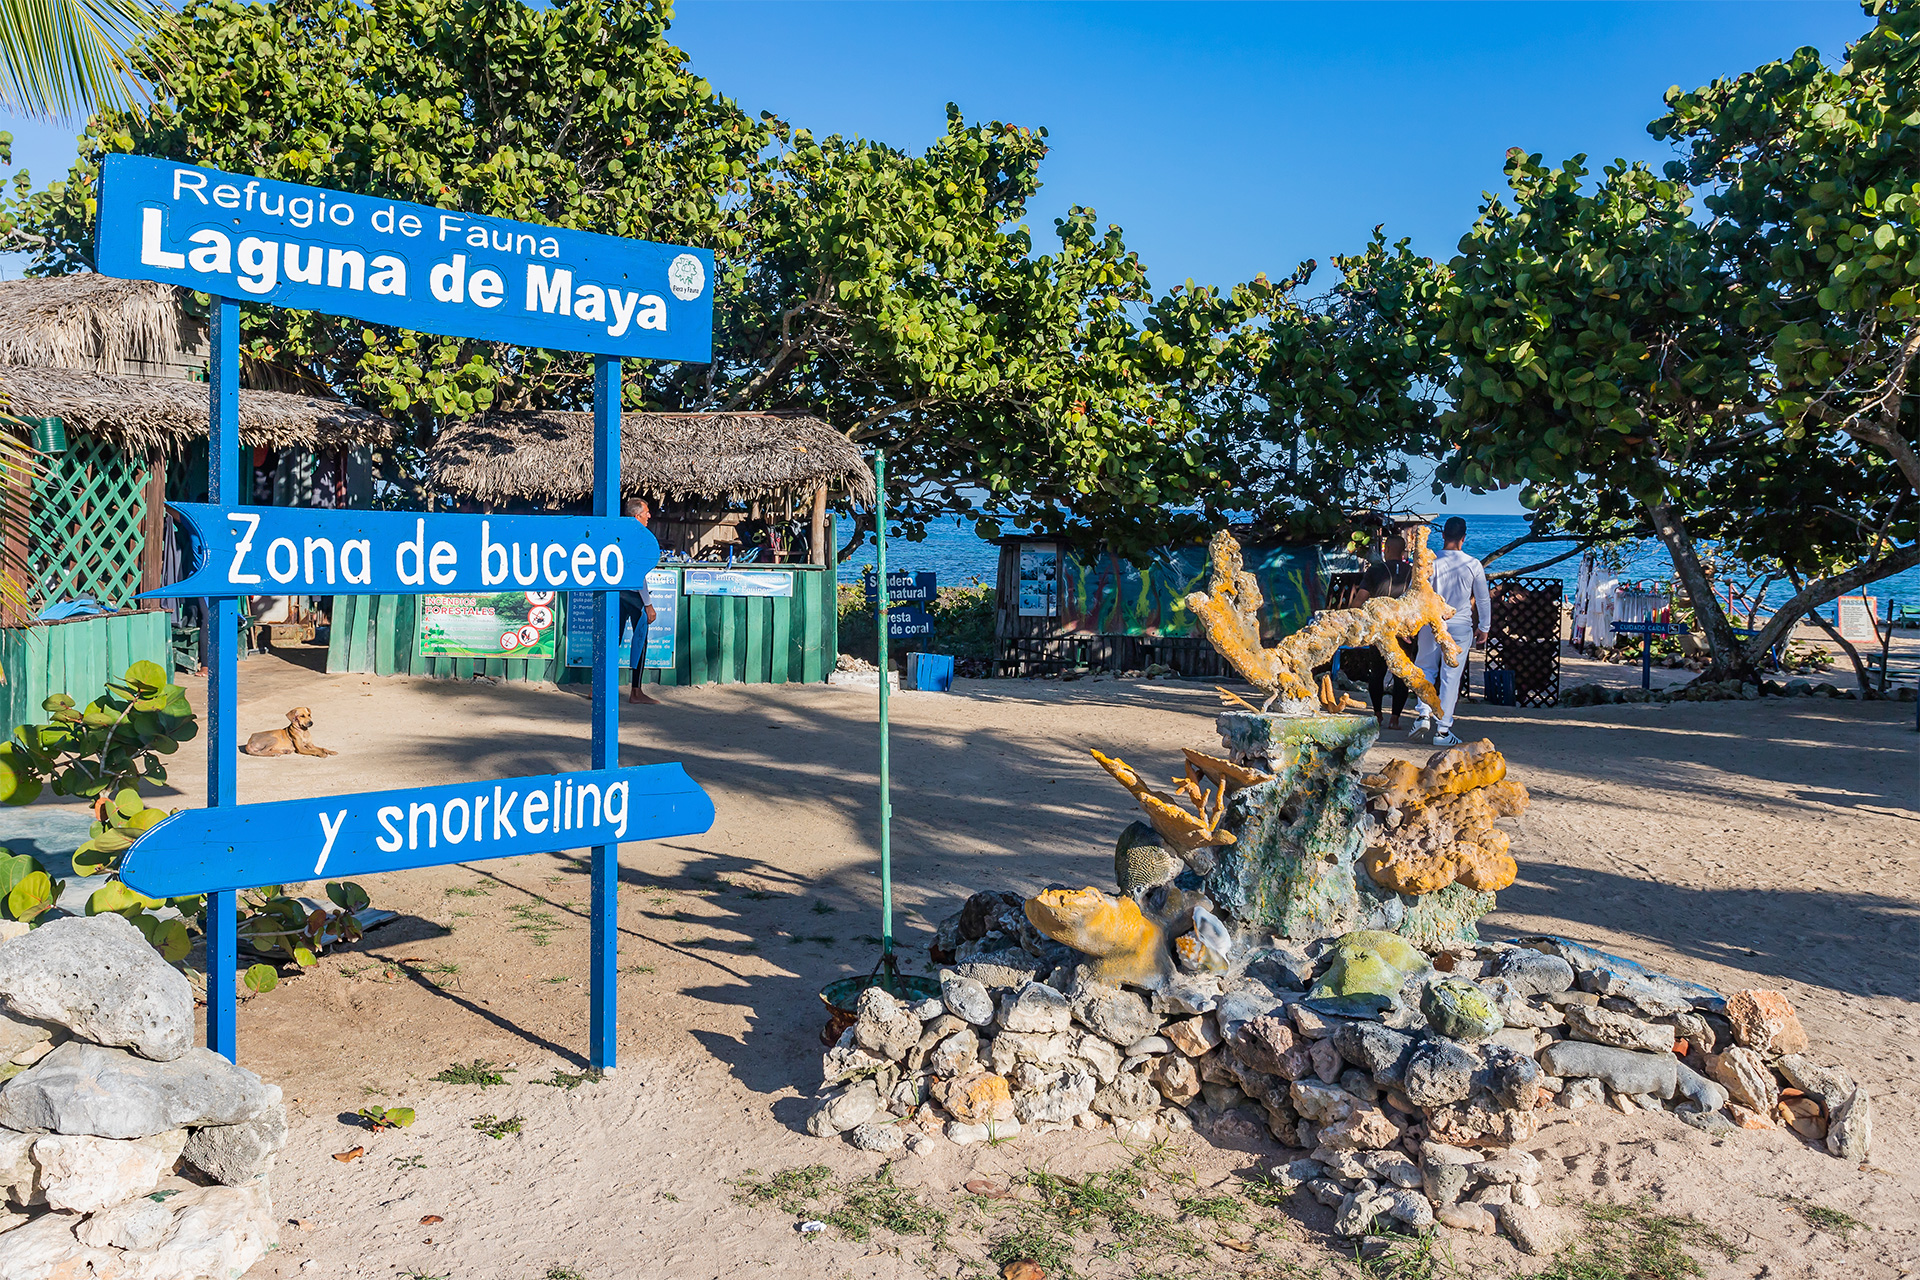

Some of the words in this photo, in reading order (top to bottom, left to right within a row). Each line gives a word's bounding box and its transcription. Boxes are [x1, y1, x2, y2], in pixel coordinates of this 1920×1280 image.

[173, 168, 355, 231] Refugio
[370, 204, 424, 238] de
[439, 213, 561, 260] Fauna
[141, 206, 407, 295] Laguna
[429, 253, 504, 309] de
[526, 264, 670, 338] Maya
[227, 512, 373, 586] Zona
[396, 517, 458, 586] de
[481, 520, 625, 586] buceo
[890, 586, 927, 599] natural
[425, 597, 477, 606] INCENDIOS
[425, 606, 495, 616] FORESTALES
[890, 624, 903, 635] de
[904, 622, 929, 634] coral
[1619, 623, 1646, 631] CUIDADO
[312, 809, 348, 876] y
[375, 780, 629, 853] snorkeling
